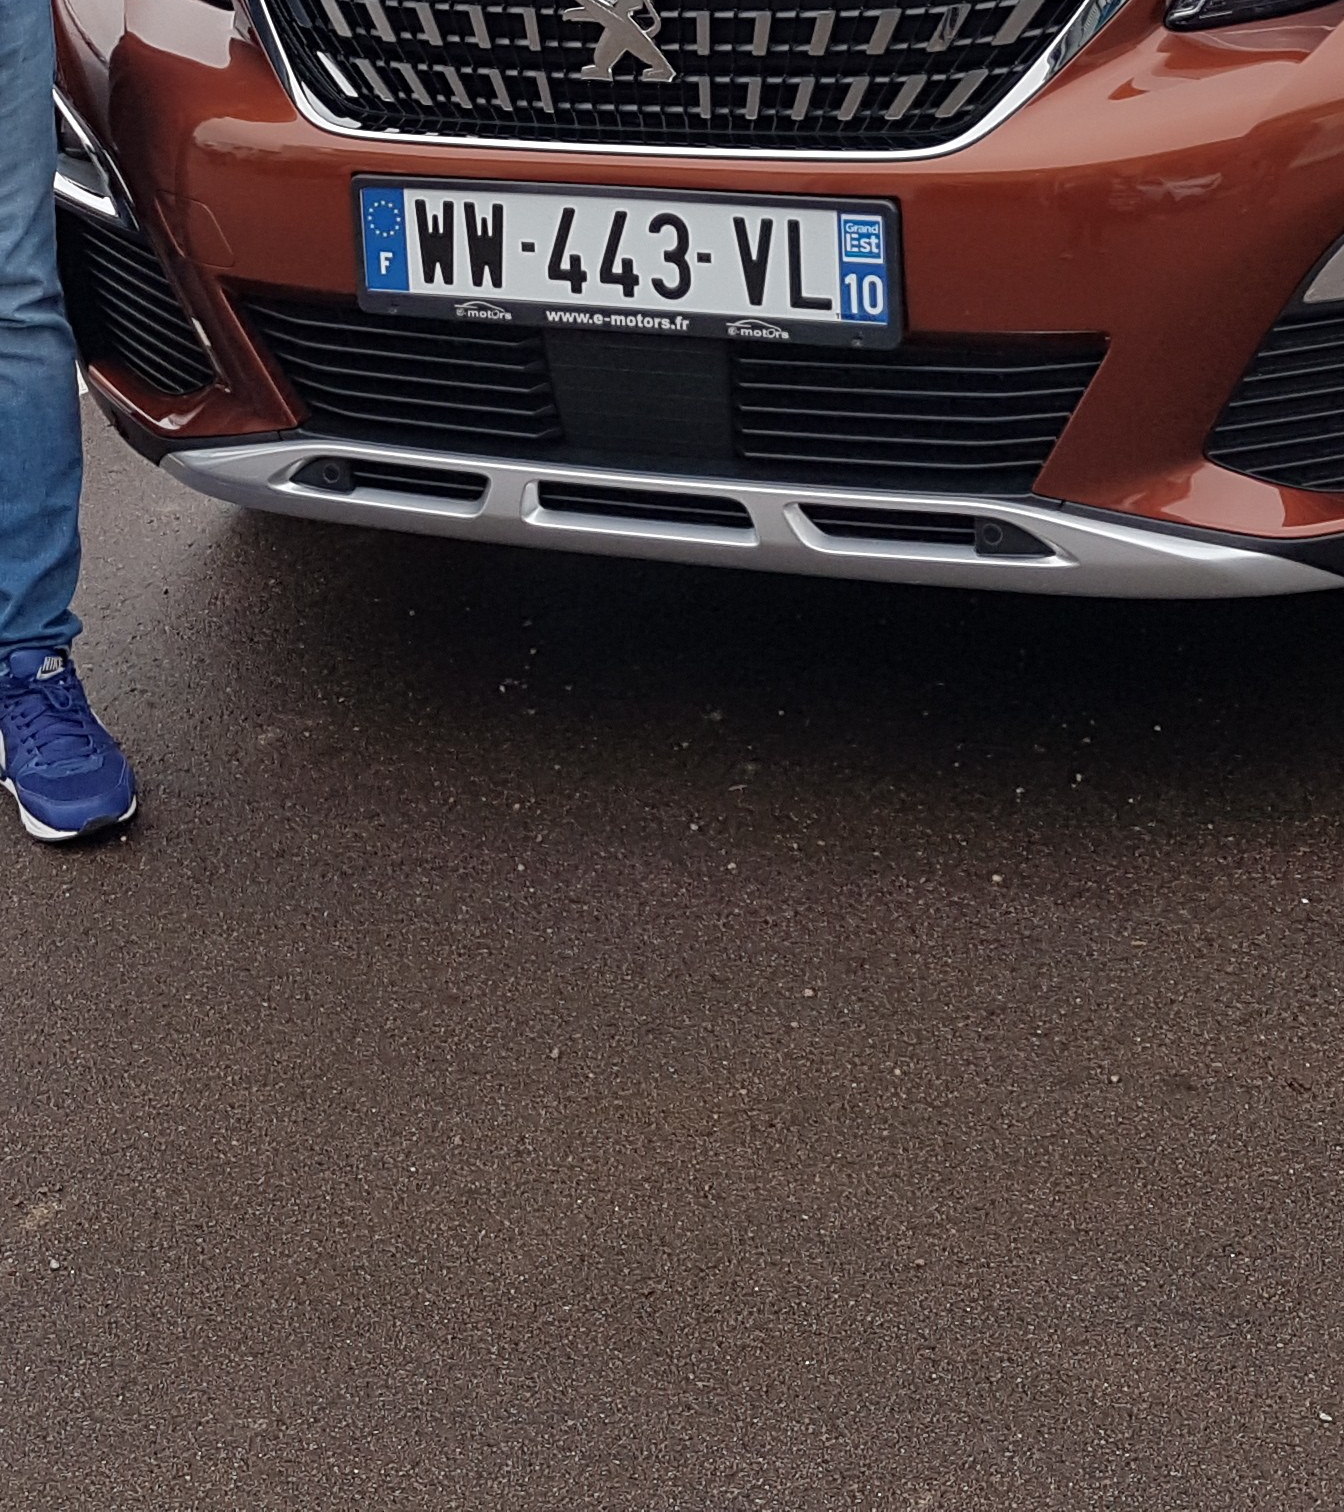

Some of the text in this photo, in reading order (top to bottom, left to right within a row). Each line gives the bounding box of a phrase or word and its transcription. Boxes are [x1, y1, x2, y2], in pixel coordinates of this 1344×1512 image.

[845, 222, 879, 234] Grand
[845, 233, 879, 253] Est
[379, 251, 394, 275] F
[414, 198, 833, 311] WW-443-VL
[844, 273, 885, 315] 10
[545, 310, 690, 331] www.e-motors.fr
[42, 656, 63, 672] NIKE
